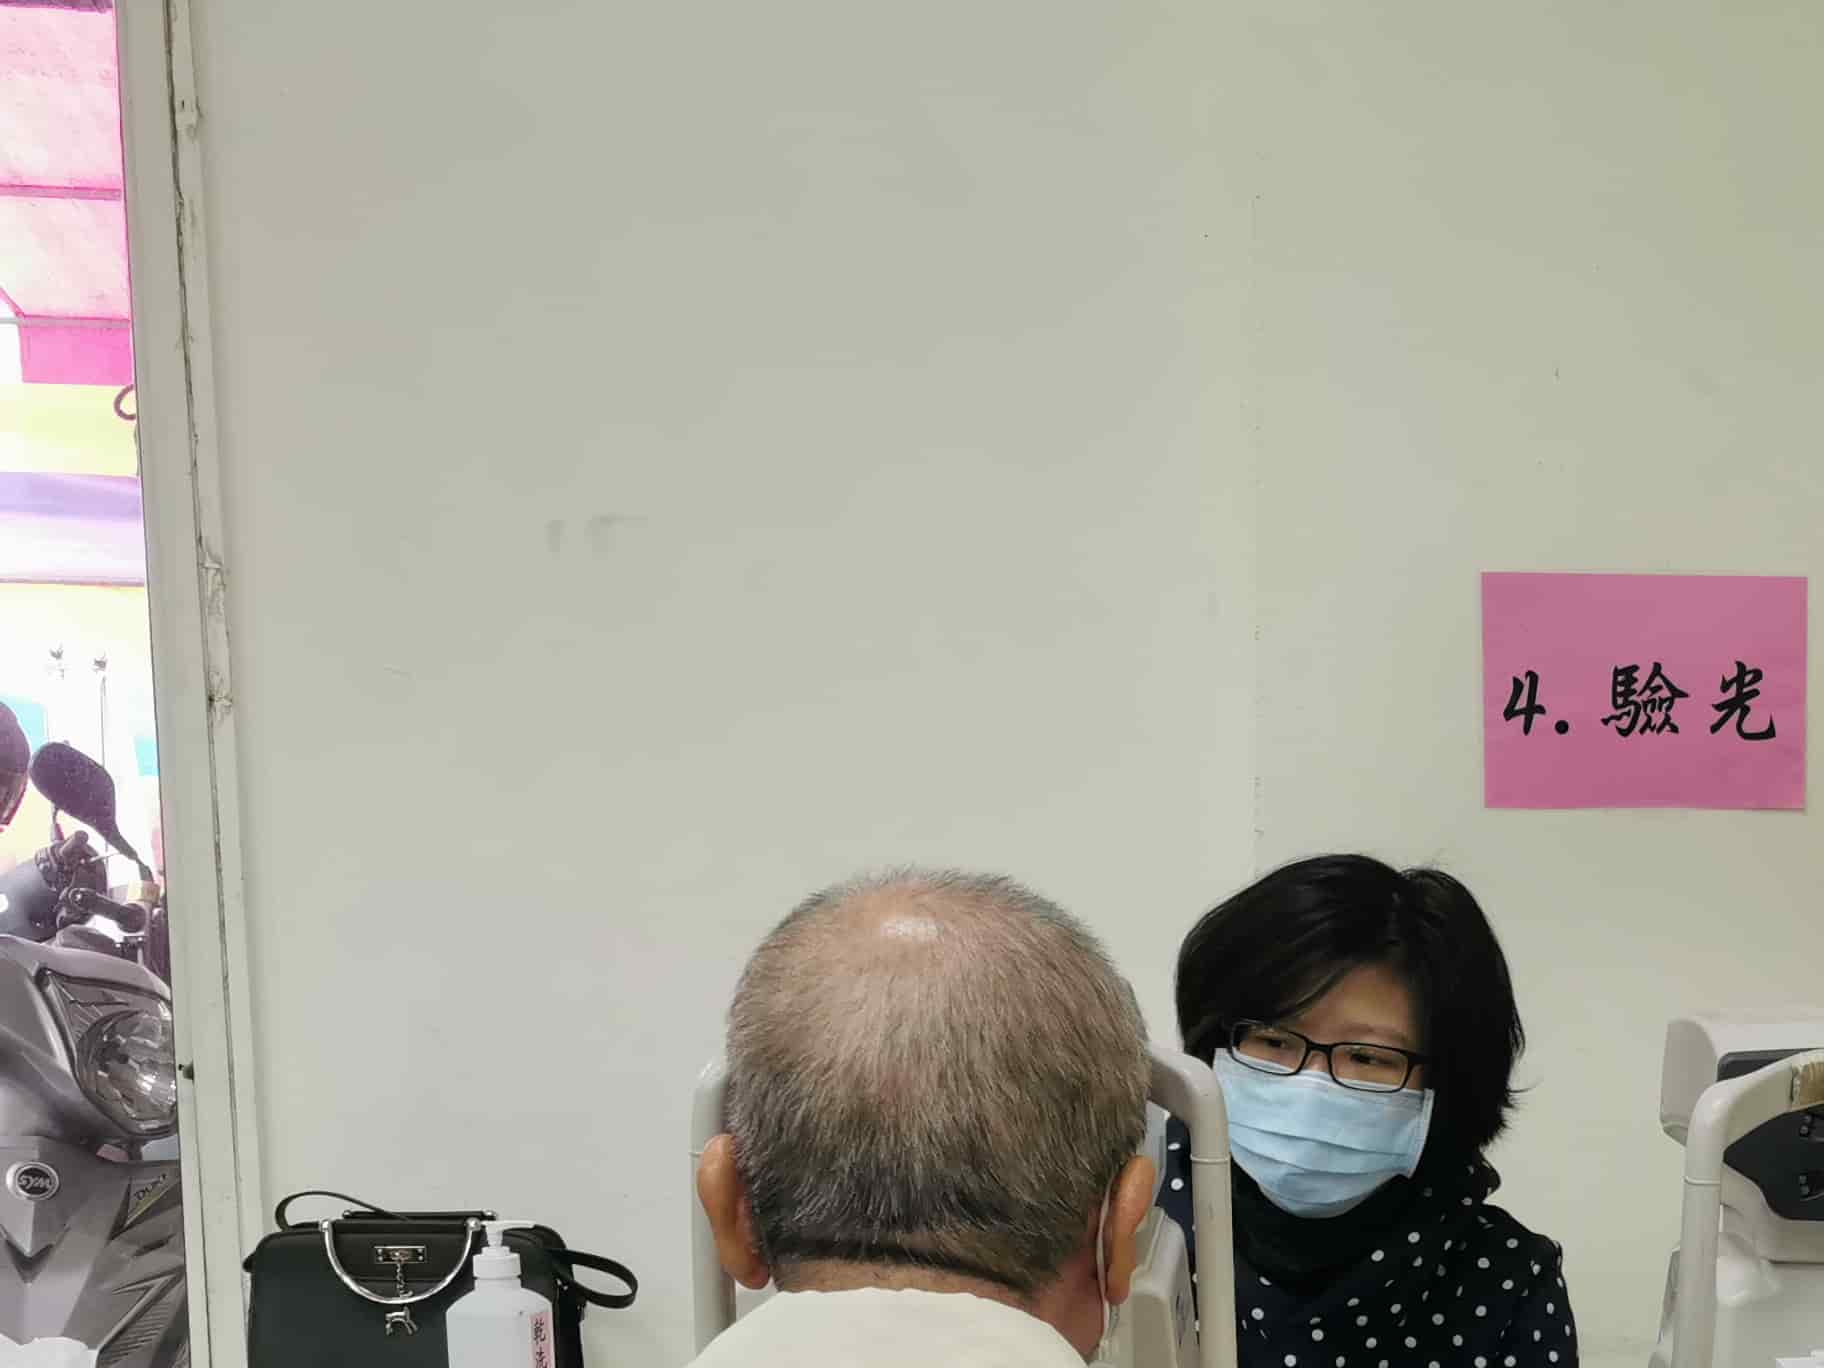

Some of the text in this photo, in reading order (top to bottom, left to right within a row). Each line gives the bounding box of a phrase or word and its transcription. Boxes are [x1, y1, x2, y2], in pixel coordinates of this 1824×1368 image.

[1502, 661, 1777, 741] 4. 驗光
[18, 1174, 52, 1191] SYM
